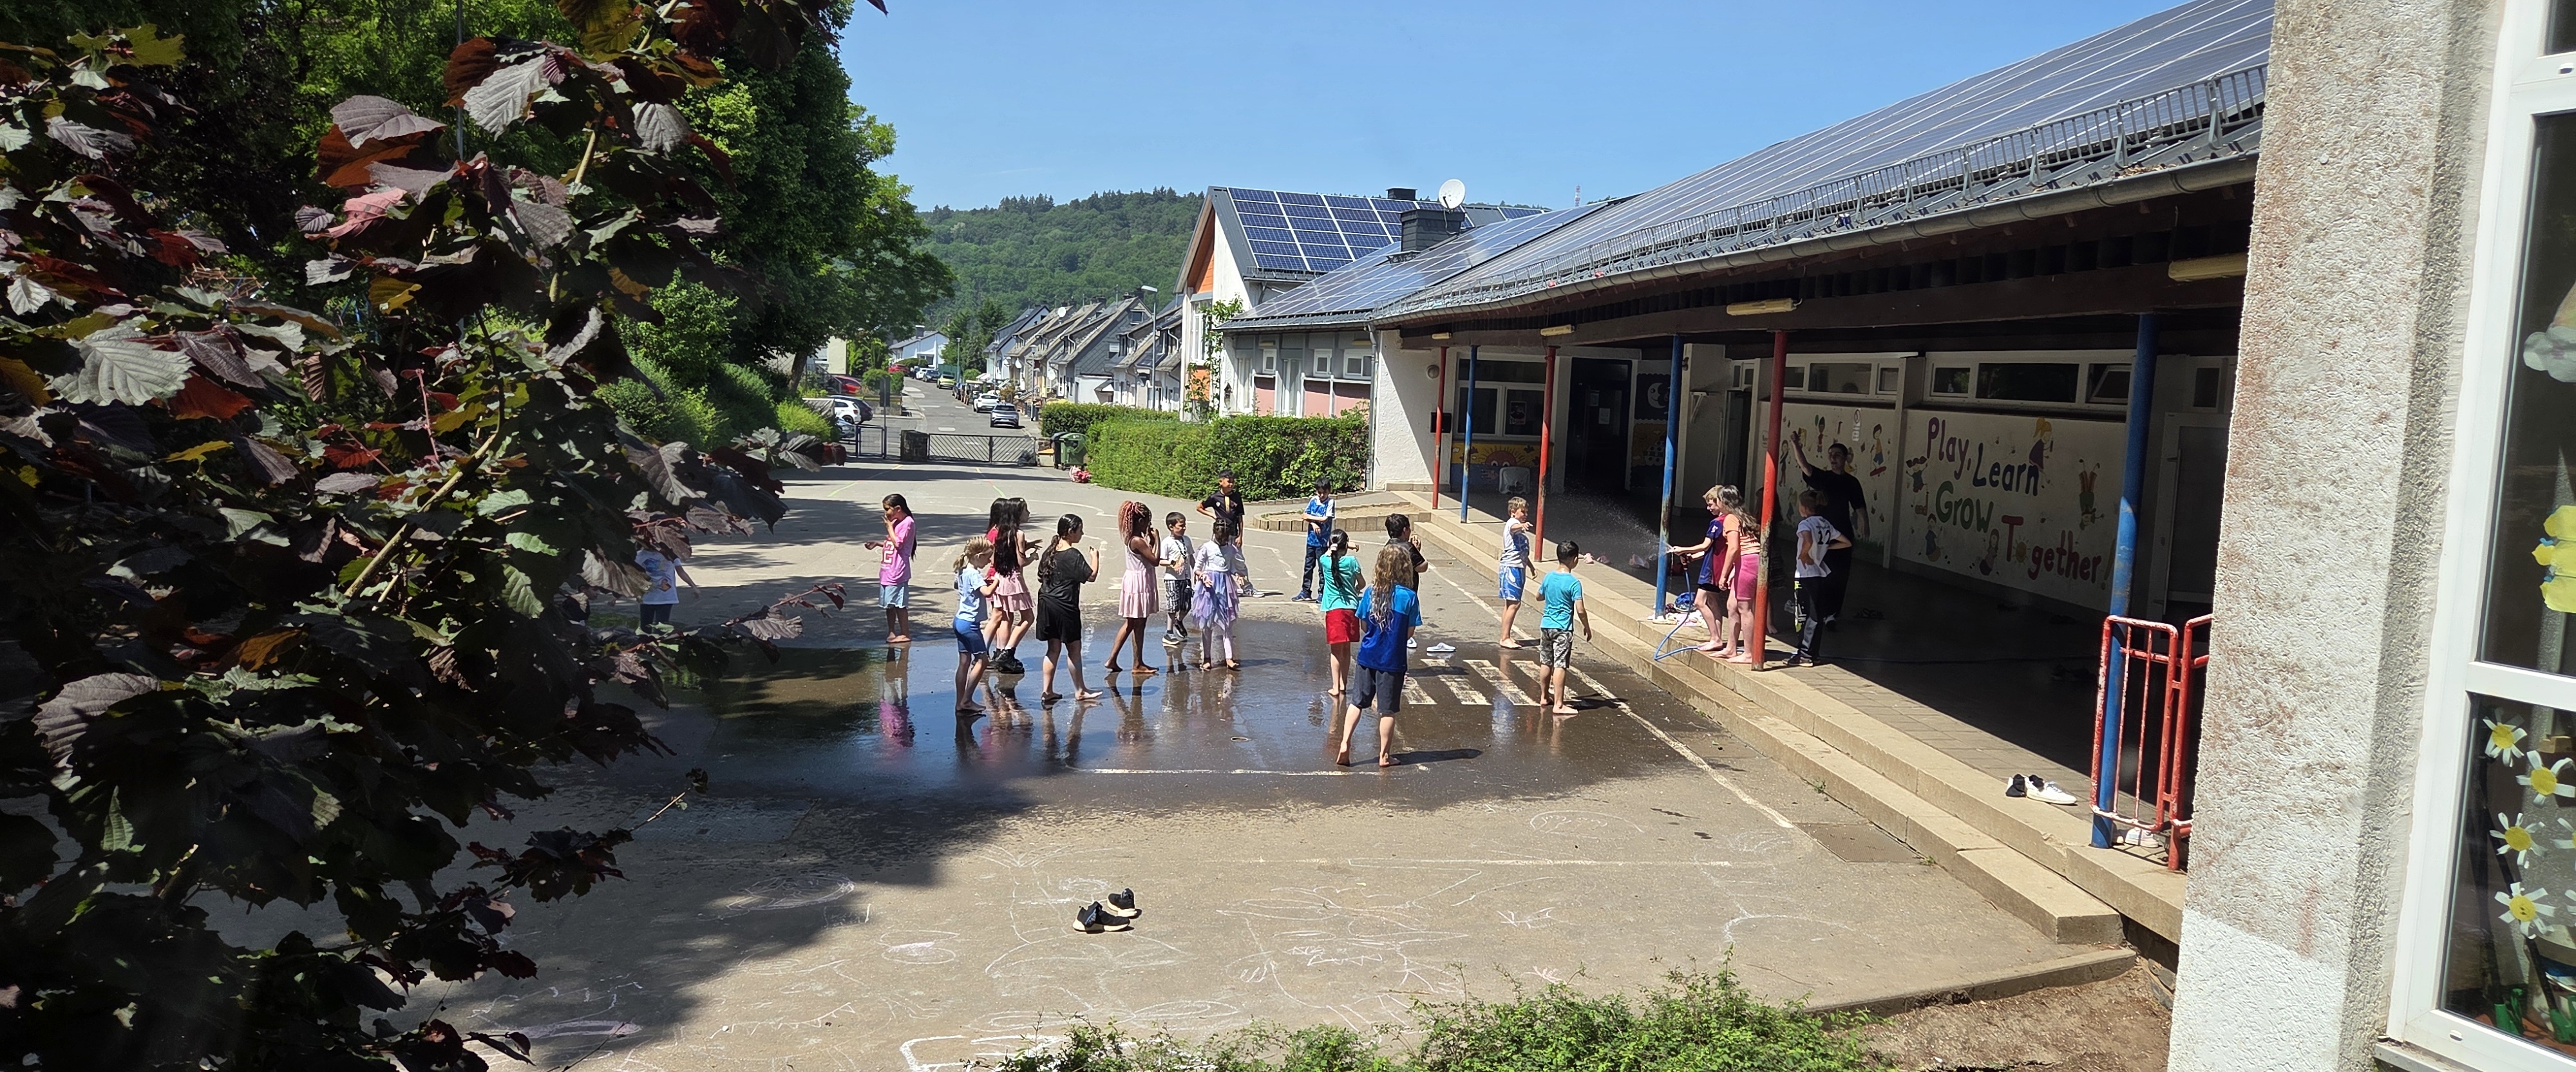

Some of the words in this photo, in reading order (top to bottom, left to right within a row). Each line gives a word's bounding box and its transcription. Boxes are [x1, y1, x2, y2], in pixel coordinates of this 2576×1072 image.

[1927, 417, 1972, 480] Play,
[1973, 442, 2040, 496] Learn
[1935, 480, 1994, 534] Grow
[1817, 529, 1831, 545] 12
